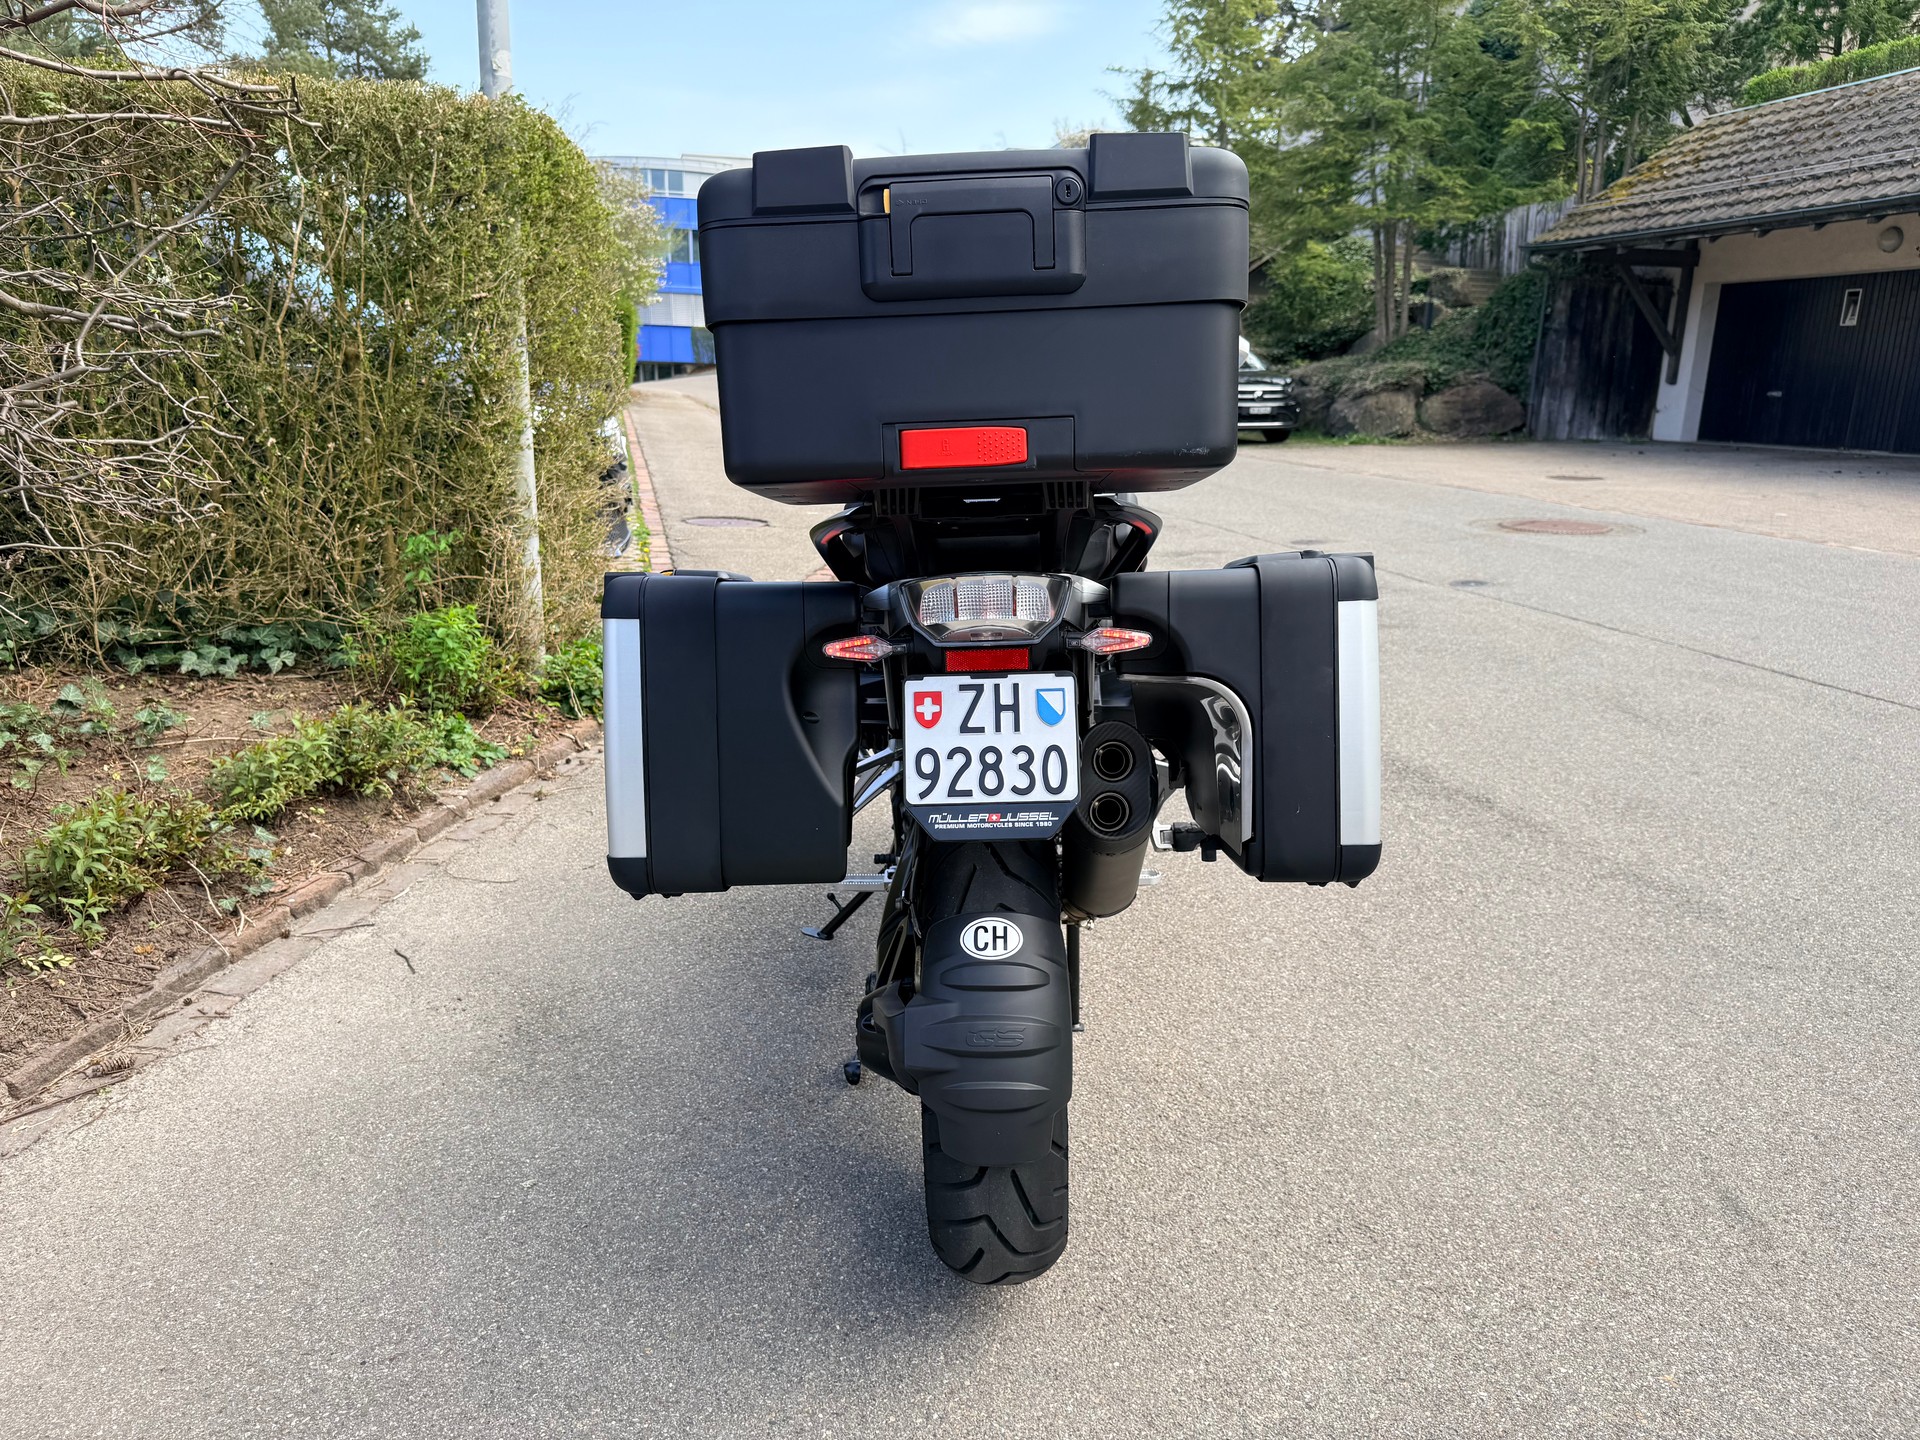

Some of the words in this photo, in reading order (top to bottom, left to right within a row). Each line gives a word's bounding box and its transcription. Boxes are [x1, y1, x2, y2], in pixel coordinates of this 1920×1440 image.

[958, 682, 1021, 734] ZH
[915, 744, 1068, 800] 92830
[928, 812, 989, 823] MÜLLER
[999, 811, 1059, 822] JUSSEL
[934, 822, 965, 830] PREMIUM
[967, 821, 1013, 829] MOTORCYCLES
[1014, 820, 1035, 828] SINCE
[973, 925, 1008, 952] CH
[965, 1027, 1026, 1048] GS
